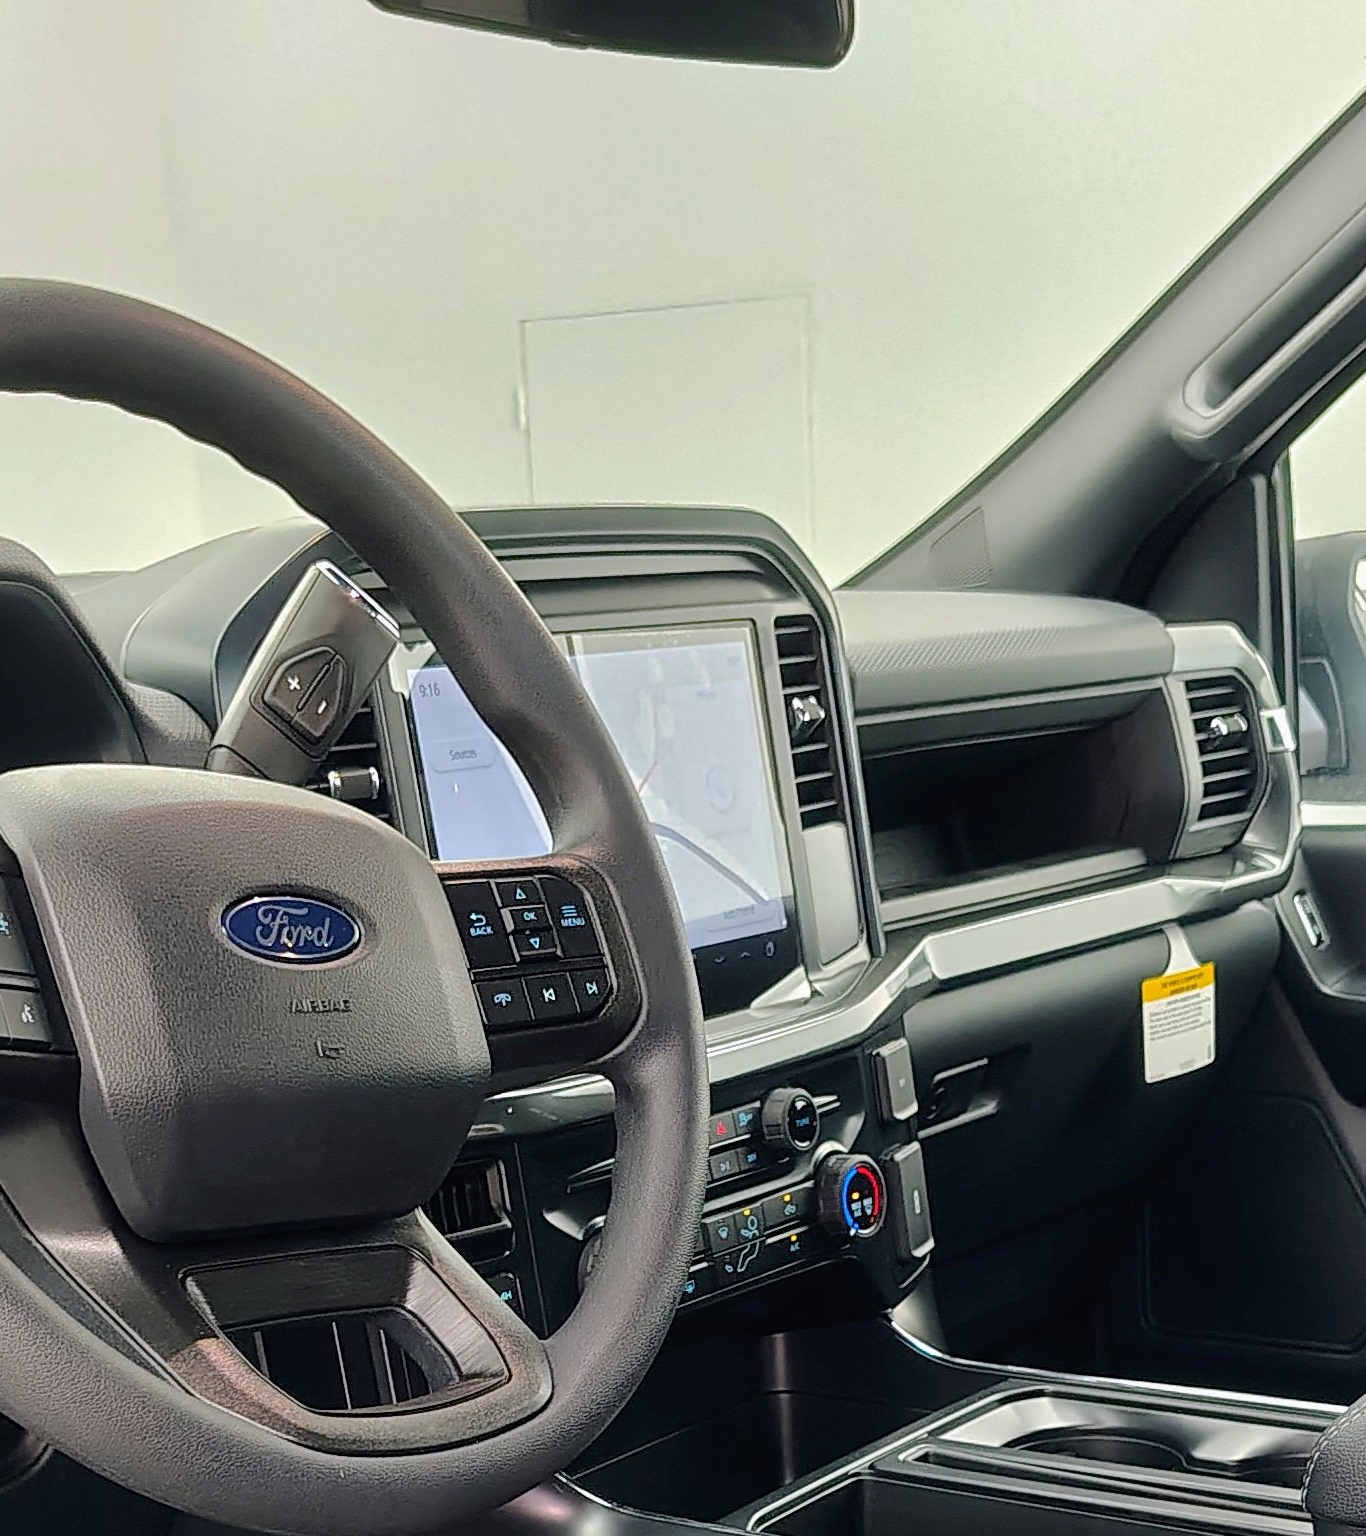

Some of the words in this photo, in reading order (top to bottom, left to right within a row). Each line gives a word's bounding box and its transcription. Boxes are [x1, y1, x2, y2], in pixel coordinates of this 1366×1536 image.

[418, 683, 441, 698] 9:16
[449, 749, 477, 761] Sources
[523, 911, 538, 921] OK
[255, 904, 335, 947] Ford
[560, 918, 586, 927] MENU
[469, 926, 494, 937] BACK
